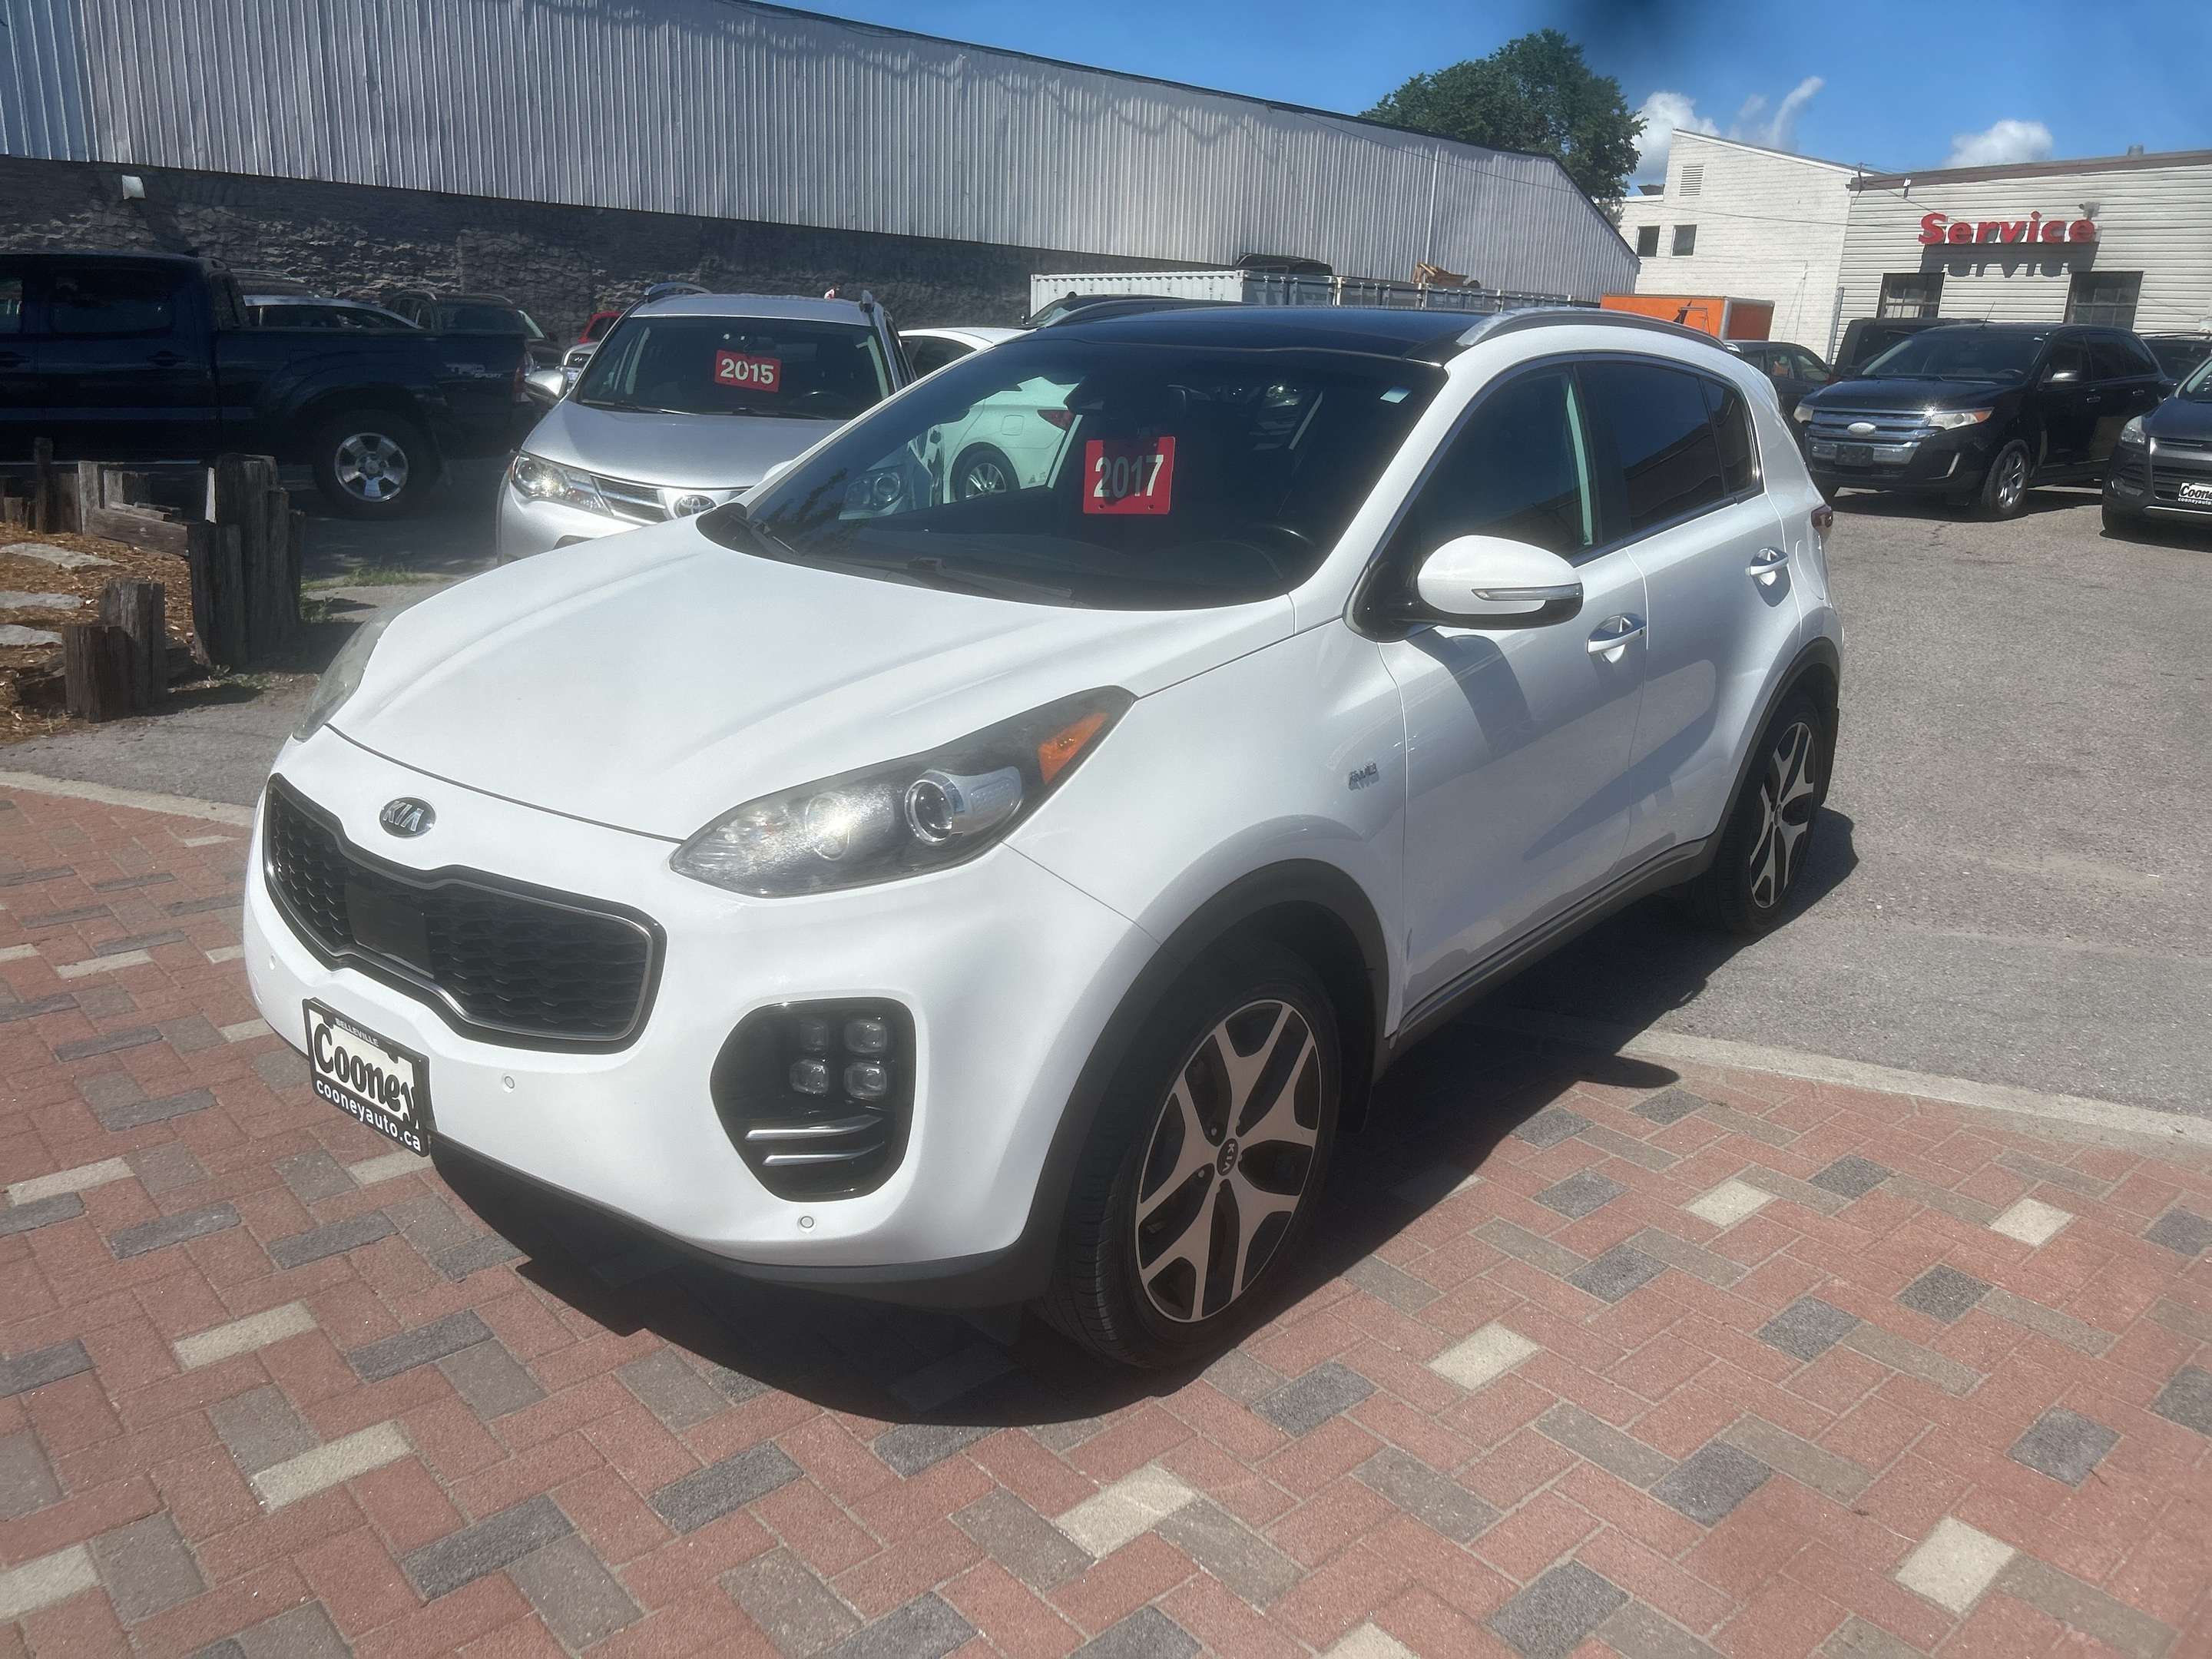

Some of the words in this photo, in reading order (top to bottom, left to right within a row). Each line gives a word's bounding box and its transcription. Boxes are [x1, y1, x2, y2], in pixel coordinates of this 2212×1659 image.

[1918, 210, 2097, 245] Service
[720, 358, 774, 385] 2015
[1094, 455, 1164, 498] 2017
[383, 800, 424, 831] KIA
[335, 1018, 379, 1047] BELLEVILLE
[316, 1080, 421, 1152] cooneyauto.ca
[1222, 1143, 1235, 1173] KIA
